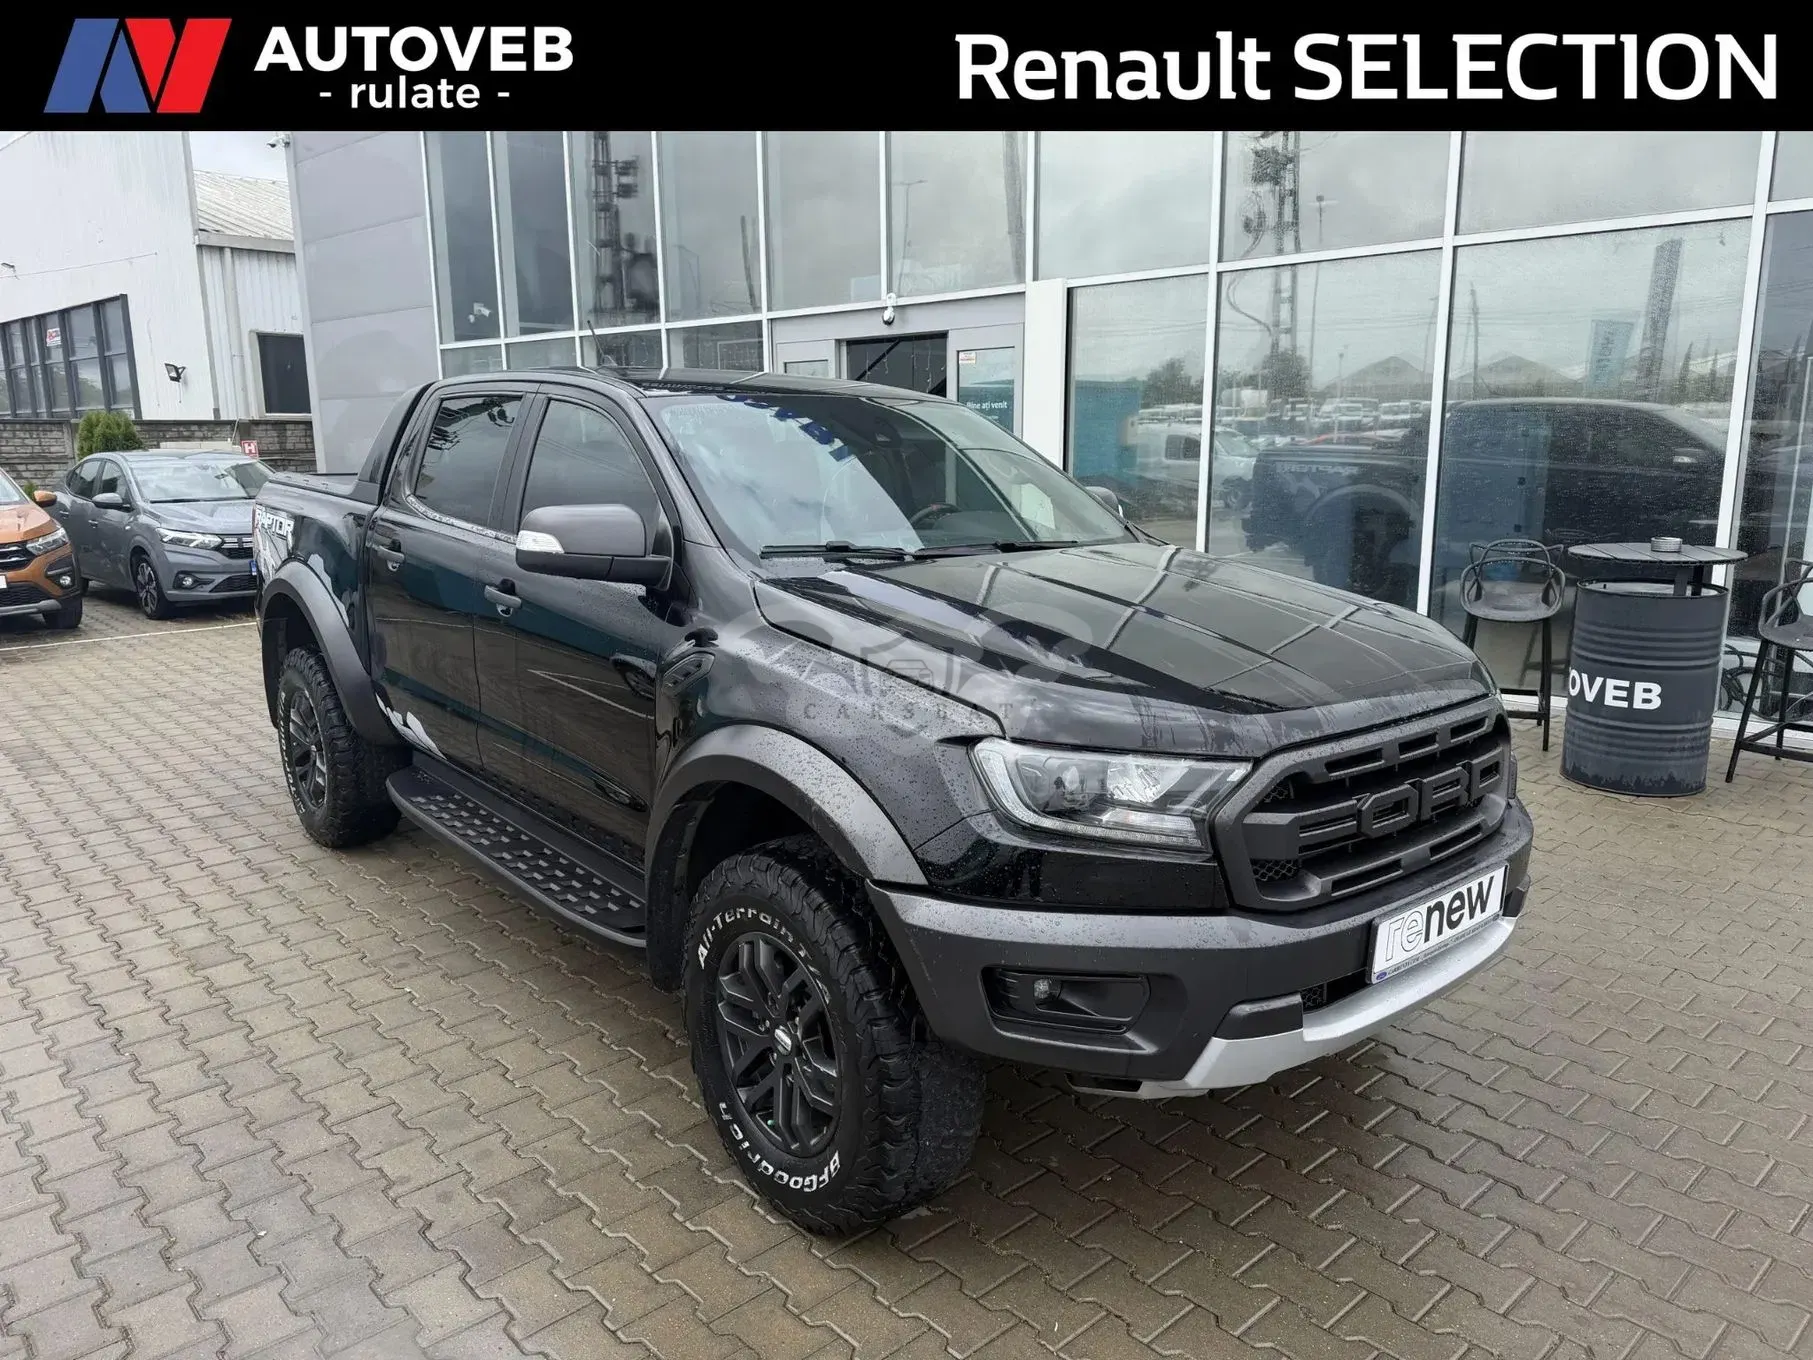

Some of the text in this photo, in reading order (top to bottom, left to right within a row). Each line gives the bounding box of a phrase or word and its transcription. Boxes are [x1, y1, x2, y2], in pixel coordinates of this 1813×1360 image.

[244, 442, 256, 454] H
[255, 508, 295, 538] RAPTOR
[1255, 747, 1501, 858] FORD
[697, 907, 795, 970] All-Terrain
[1385, 875, 1495, 962] renew
[719, 1101, 841, 1193] BFGoodrich
